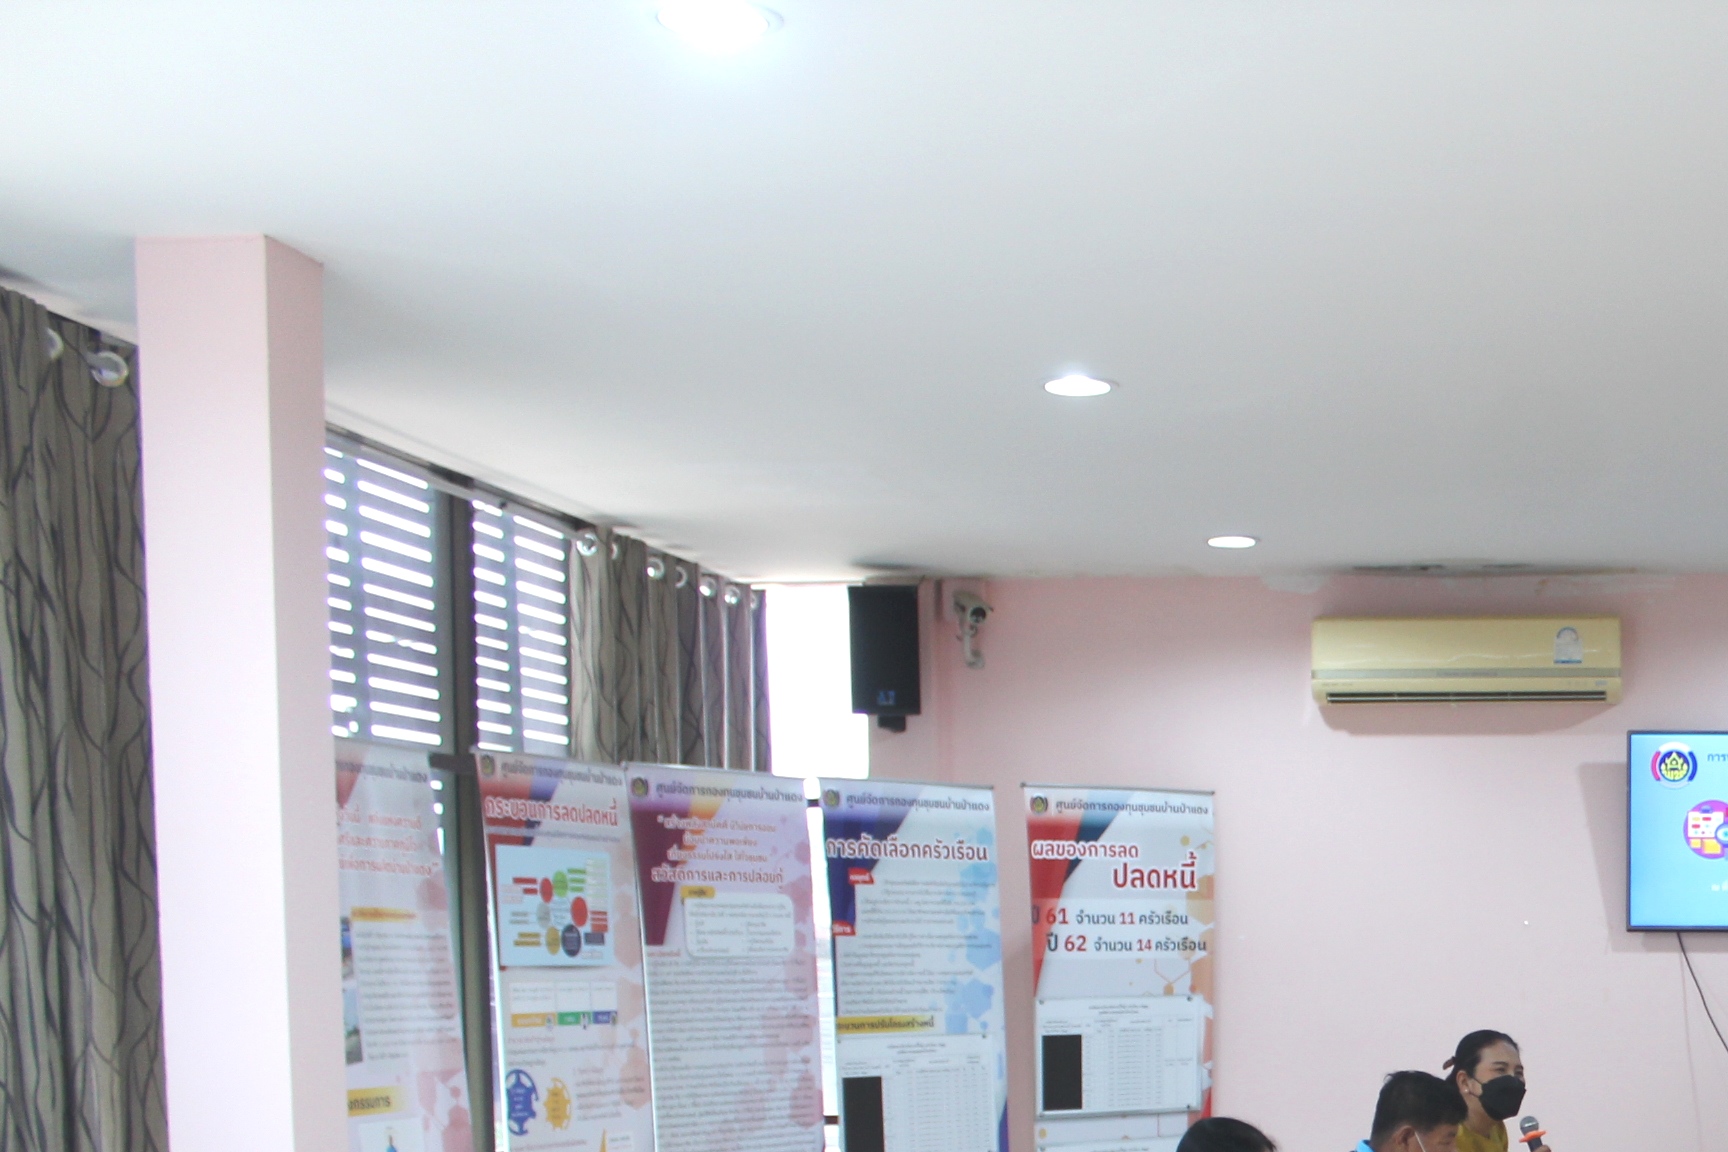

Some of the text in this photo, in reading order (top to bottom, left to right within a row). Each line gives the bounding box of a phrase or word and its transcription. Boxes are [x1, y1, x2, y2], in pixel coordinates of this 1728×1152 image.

[1056, 798, 1209, 816] ศูนย์จัดการกองทุนชุมชนบ้านป่าแดง
[826, 833, 988, 861] การคัดเลือกครัวเรือน
[1033, 843, 1139, 858] ผลของการลด
[1113, 853, 1197, 889] ปลดหนี้
[1046, 908, 1069, 924] 61
[1076, 910, 1115, 924] จำนวน
[1120, 912, 1135, 924] 11
[1139, 909, 1188, 924] ครัวเรือน
[1047, 931, 1207, 951] ปี 62 จำนวน 14 ครัวเรือน
